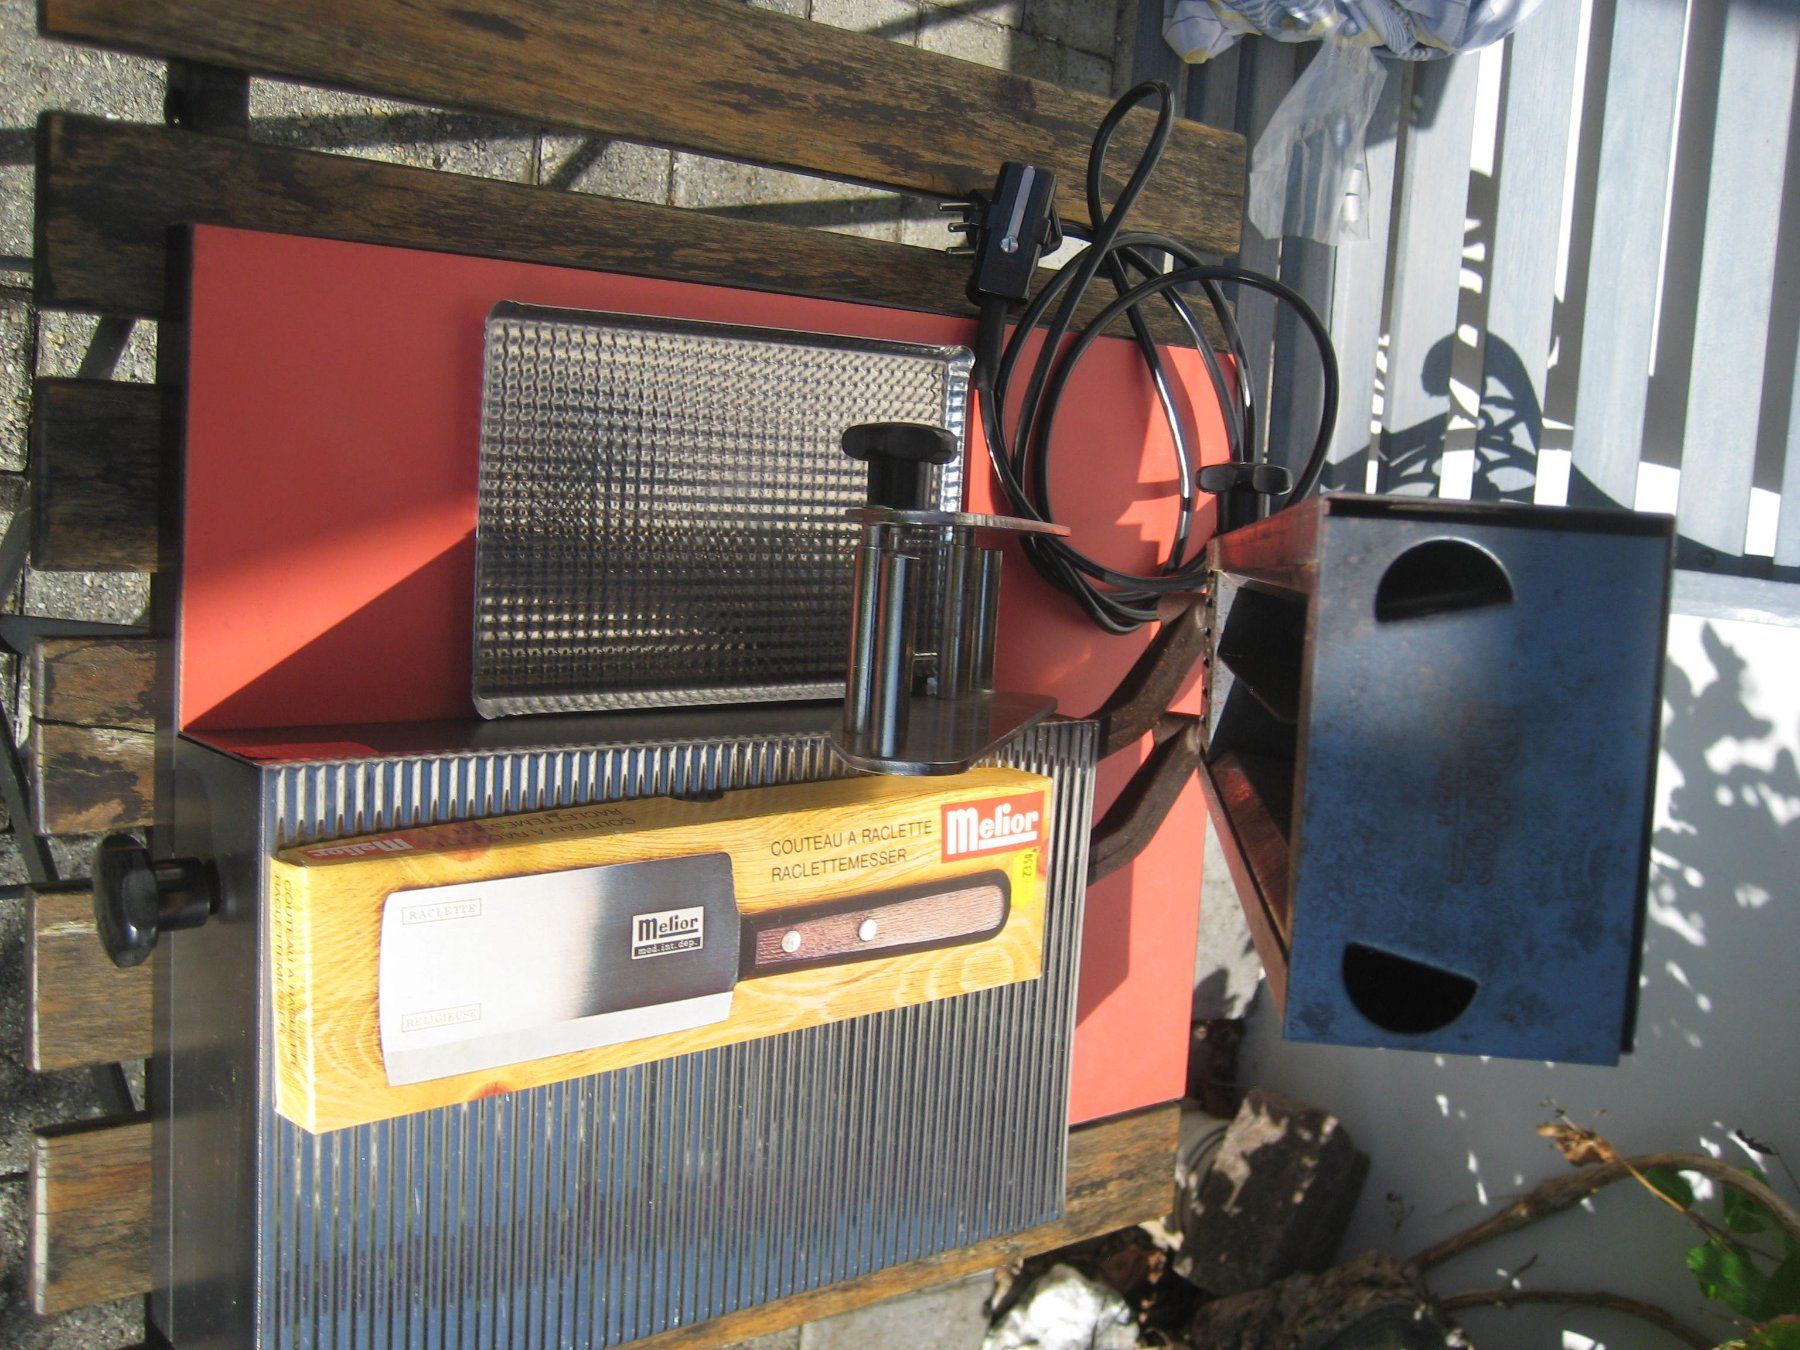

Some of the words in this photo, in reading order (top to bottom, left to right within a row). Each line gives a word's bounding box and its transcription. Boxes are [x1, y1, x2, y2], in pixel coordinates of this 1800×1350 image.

[771, 832, 843, 857] COUTEAU
[847, 831, 858, 845] A
[862, 820, 933, 843] RACLETTE
[947, 803, 1039, 855] Melior
[771, 848, 907, 882] RACLETTEMESSER
[409, 903, 476, 920] RACLETTE
[638, 915, 699, 942] Melior
